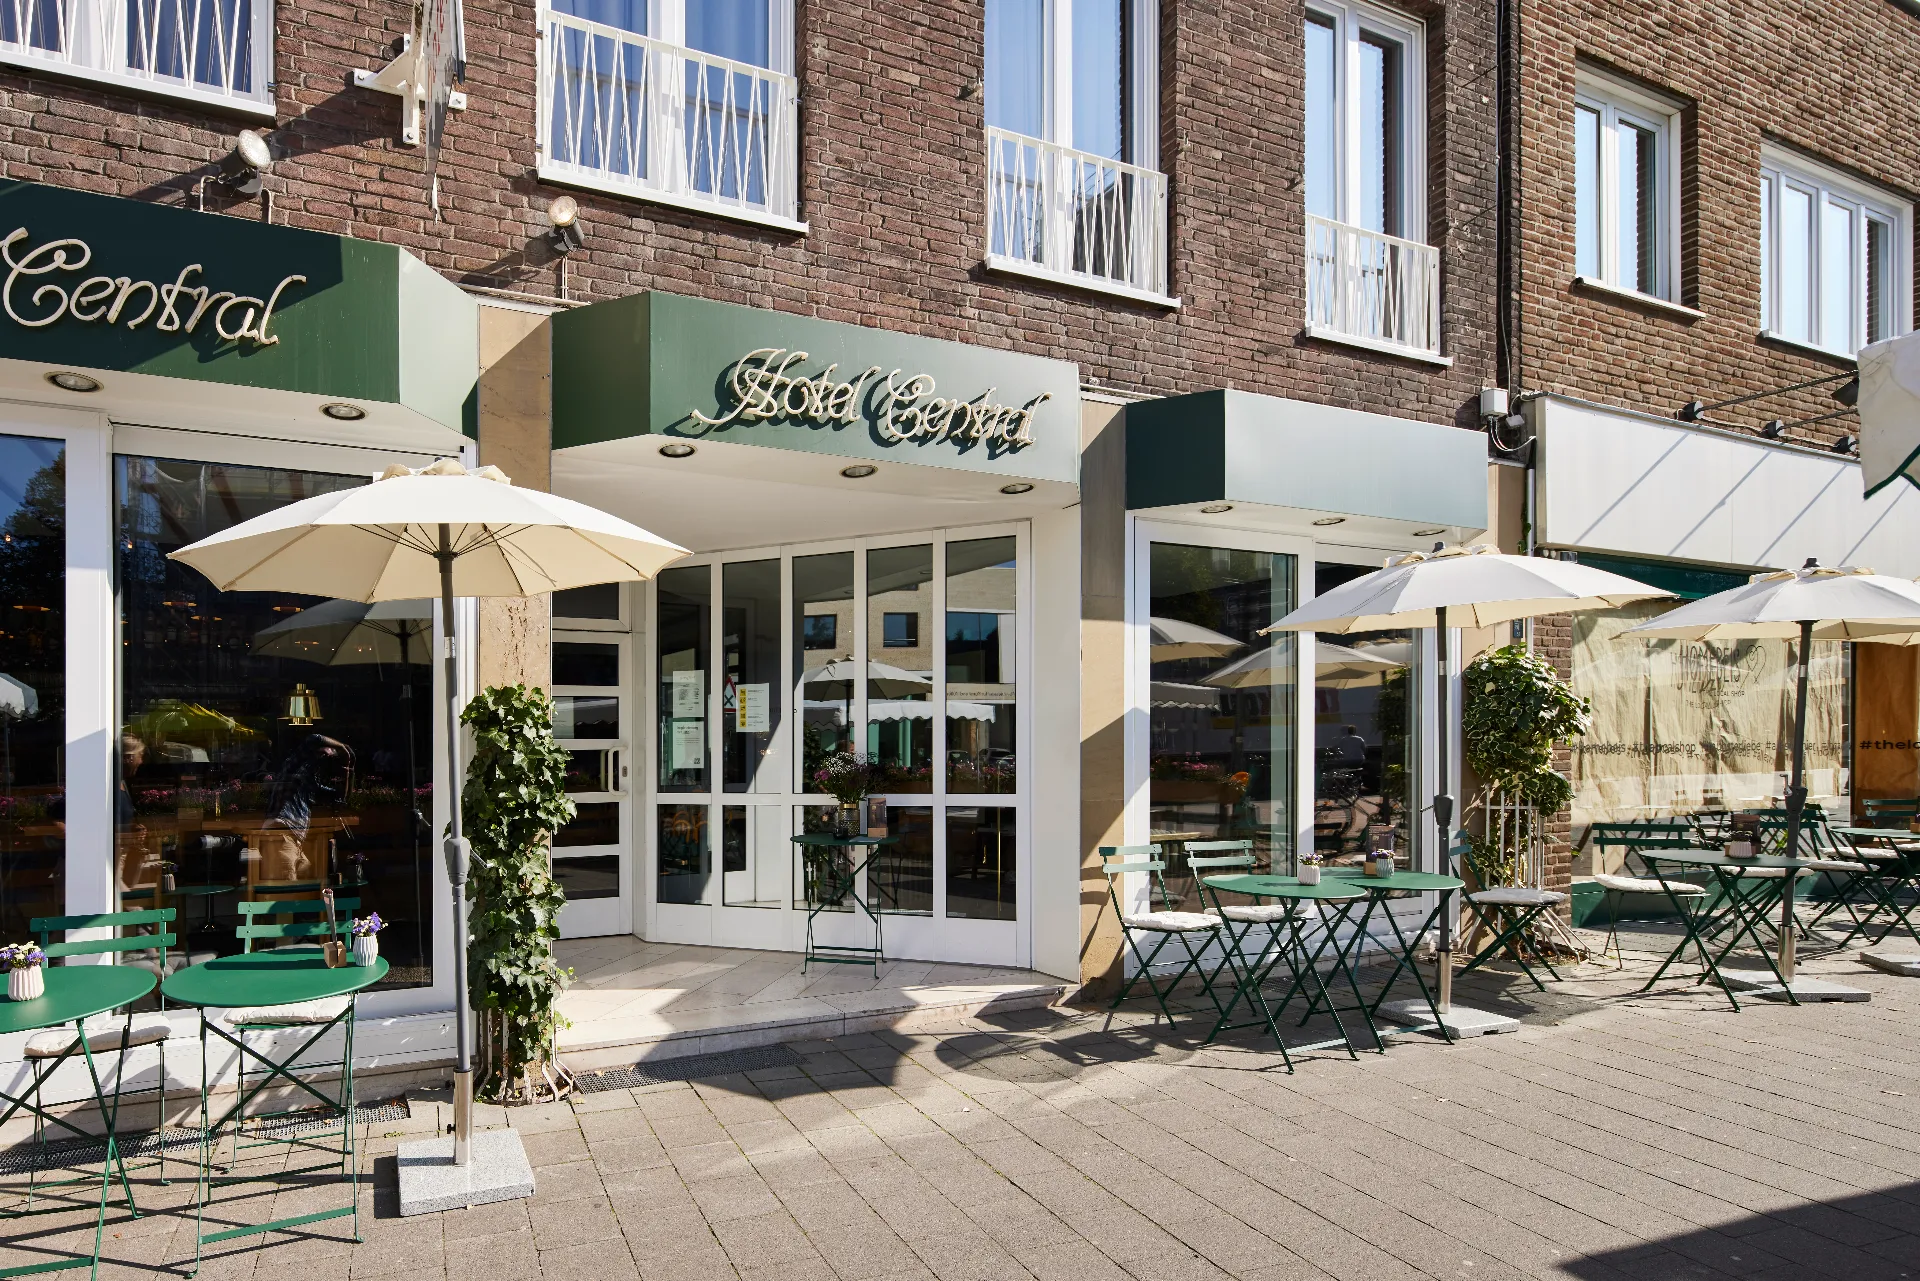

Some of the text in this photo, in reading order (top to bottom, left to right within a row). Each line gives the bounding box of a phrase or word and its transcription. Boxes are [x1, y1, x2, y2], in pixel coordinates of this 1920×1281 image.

[1, 226, 307, 345] Central
[690, 347, 1054, 446] Hotel Central
